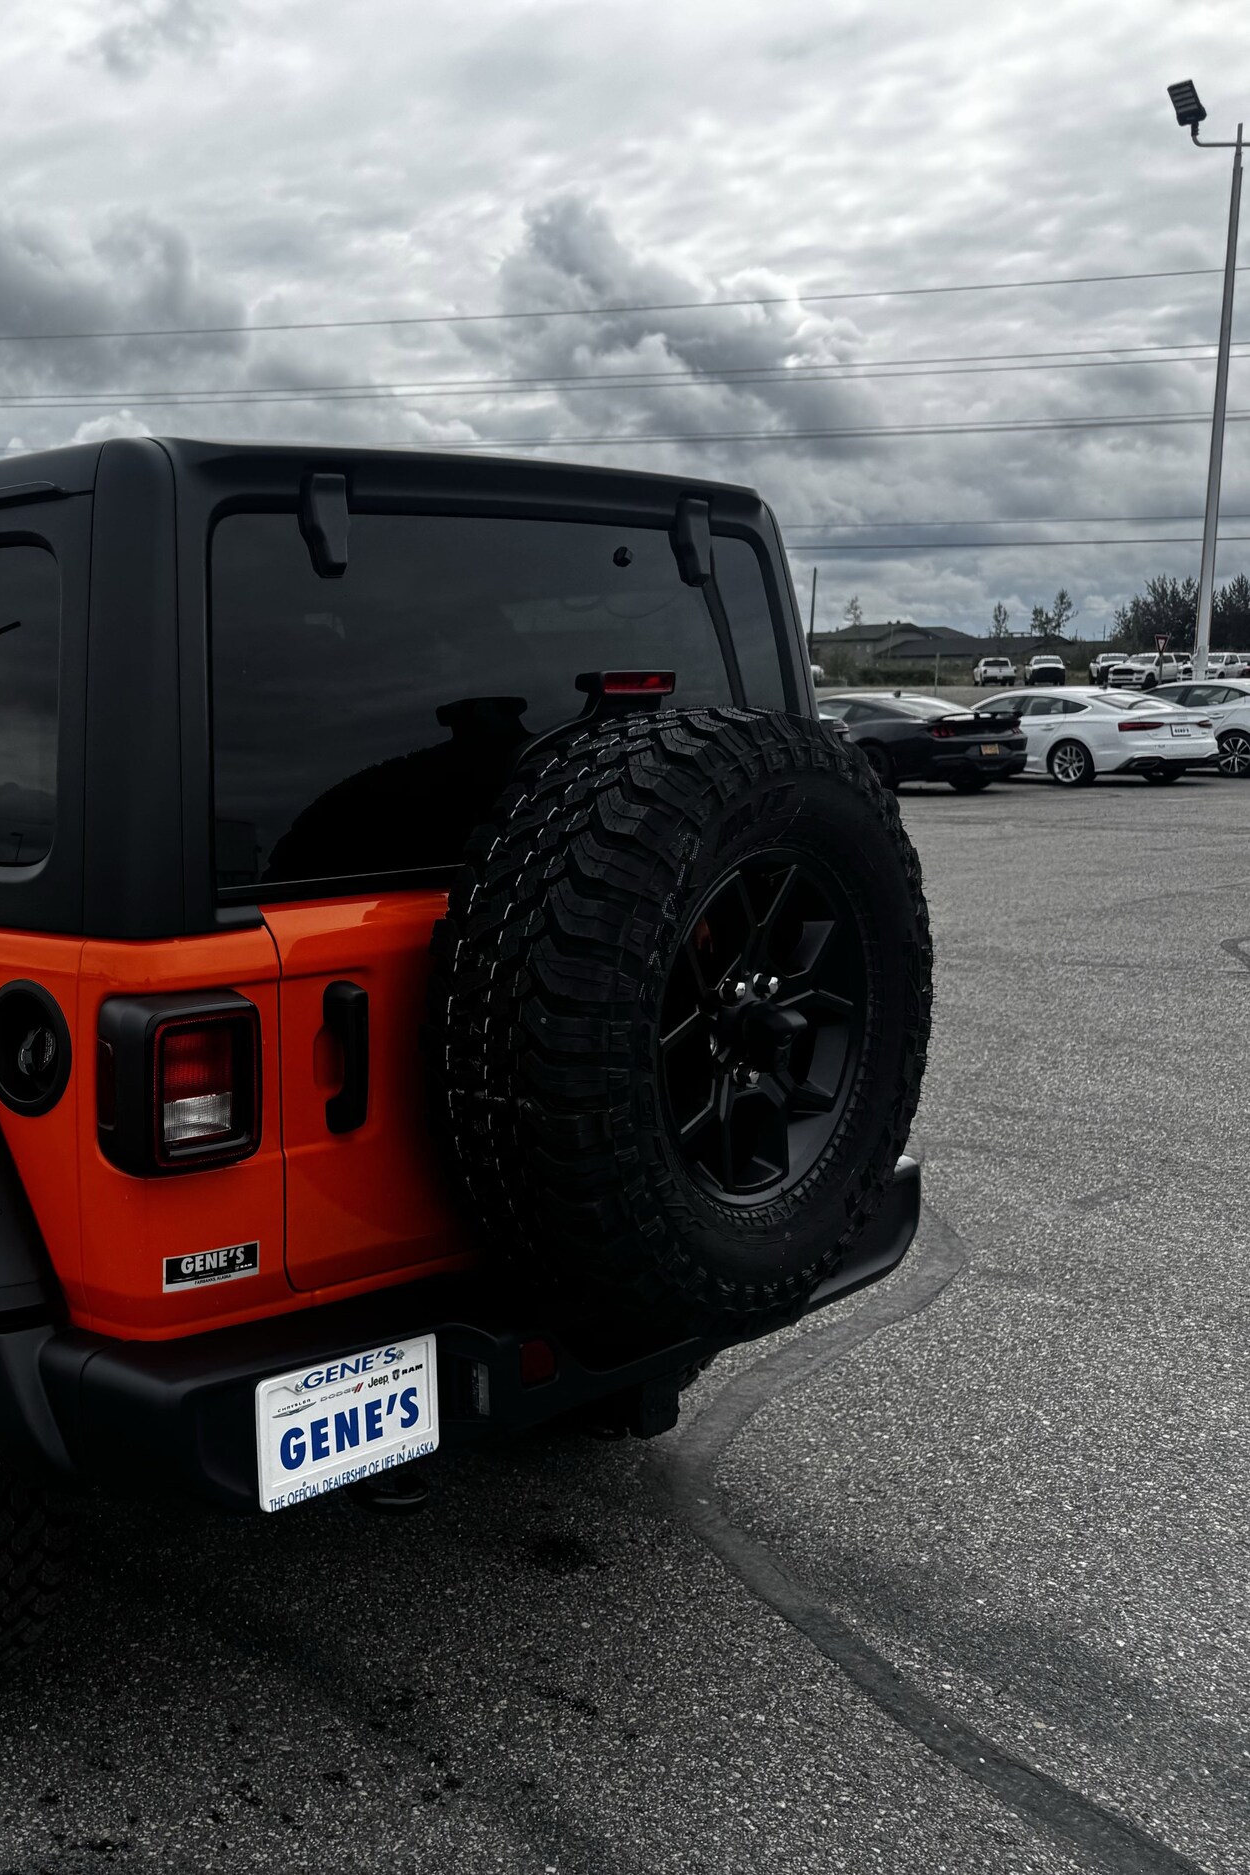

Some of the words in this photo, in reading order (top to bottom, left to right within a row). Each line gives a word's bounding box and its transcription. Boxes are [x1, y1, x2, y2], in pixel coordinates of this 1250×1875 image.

[180, 1247, 245, 1274] GENE'S
[277, 1398, 312, 1413] CHRYSLER
[367, 1374, 390, 1389] Jeep
[401, 1363, 423, 1376] RAM
[303, 1347, 397, 1389] GENE'S
[279, 1386, 420, 1471] GENE'S
[269, 1494, 285, 1512] THE
[287, 1482, 320, 1506] OFFICIAL
[322, 1464, 368, 1493] DEALERSHIP
[368, 1459, 380, 1475] OF
[381, 1455, 396, 1471] LIFE
[396, 1450, 405, 1466] IN
[407, 1441, 435, 1461] ALASKA
